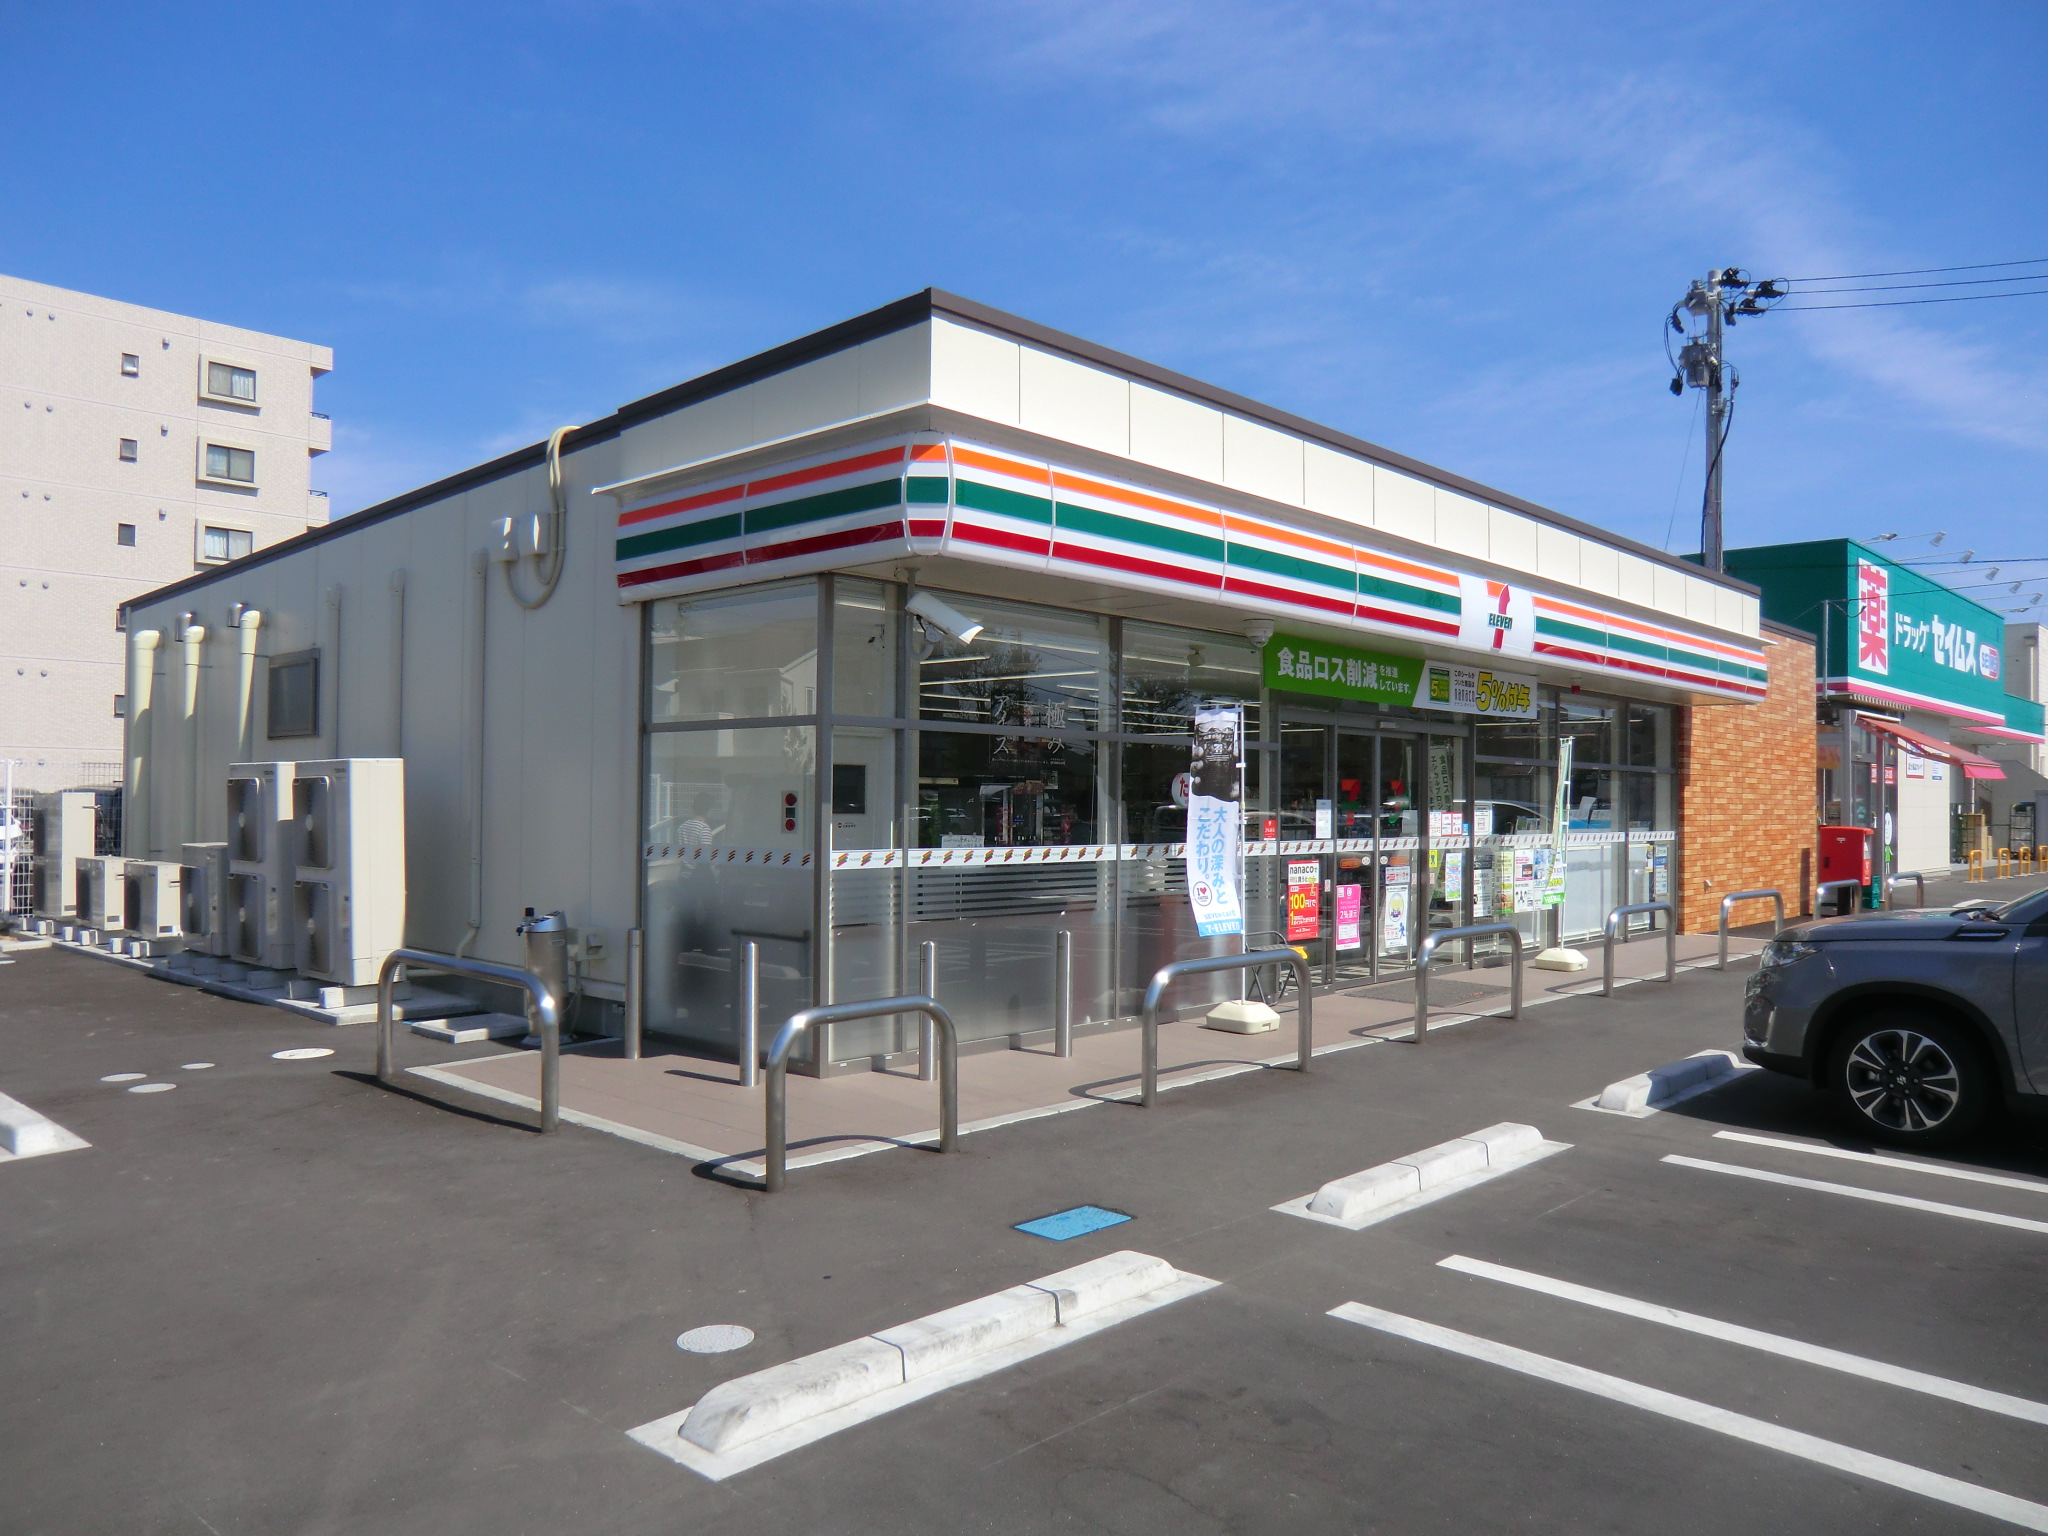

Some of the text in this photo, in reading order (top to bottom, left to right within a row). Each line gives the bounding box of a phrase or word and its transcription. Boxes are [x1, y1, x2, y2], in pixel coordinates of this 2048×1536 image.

[1859, 563, 1887, 669] 薬
[1277, 646, 1378, 690] 食品ロス削減
[1454, 688, 1475, 702] nanaco
[1476, 671, 1530, 712] 5%付与
[1211, 806, 1228, 904] 大人の深みと
